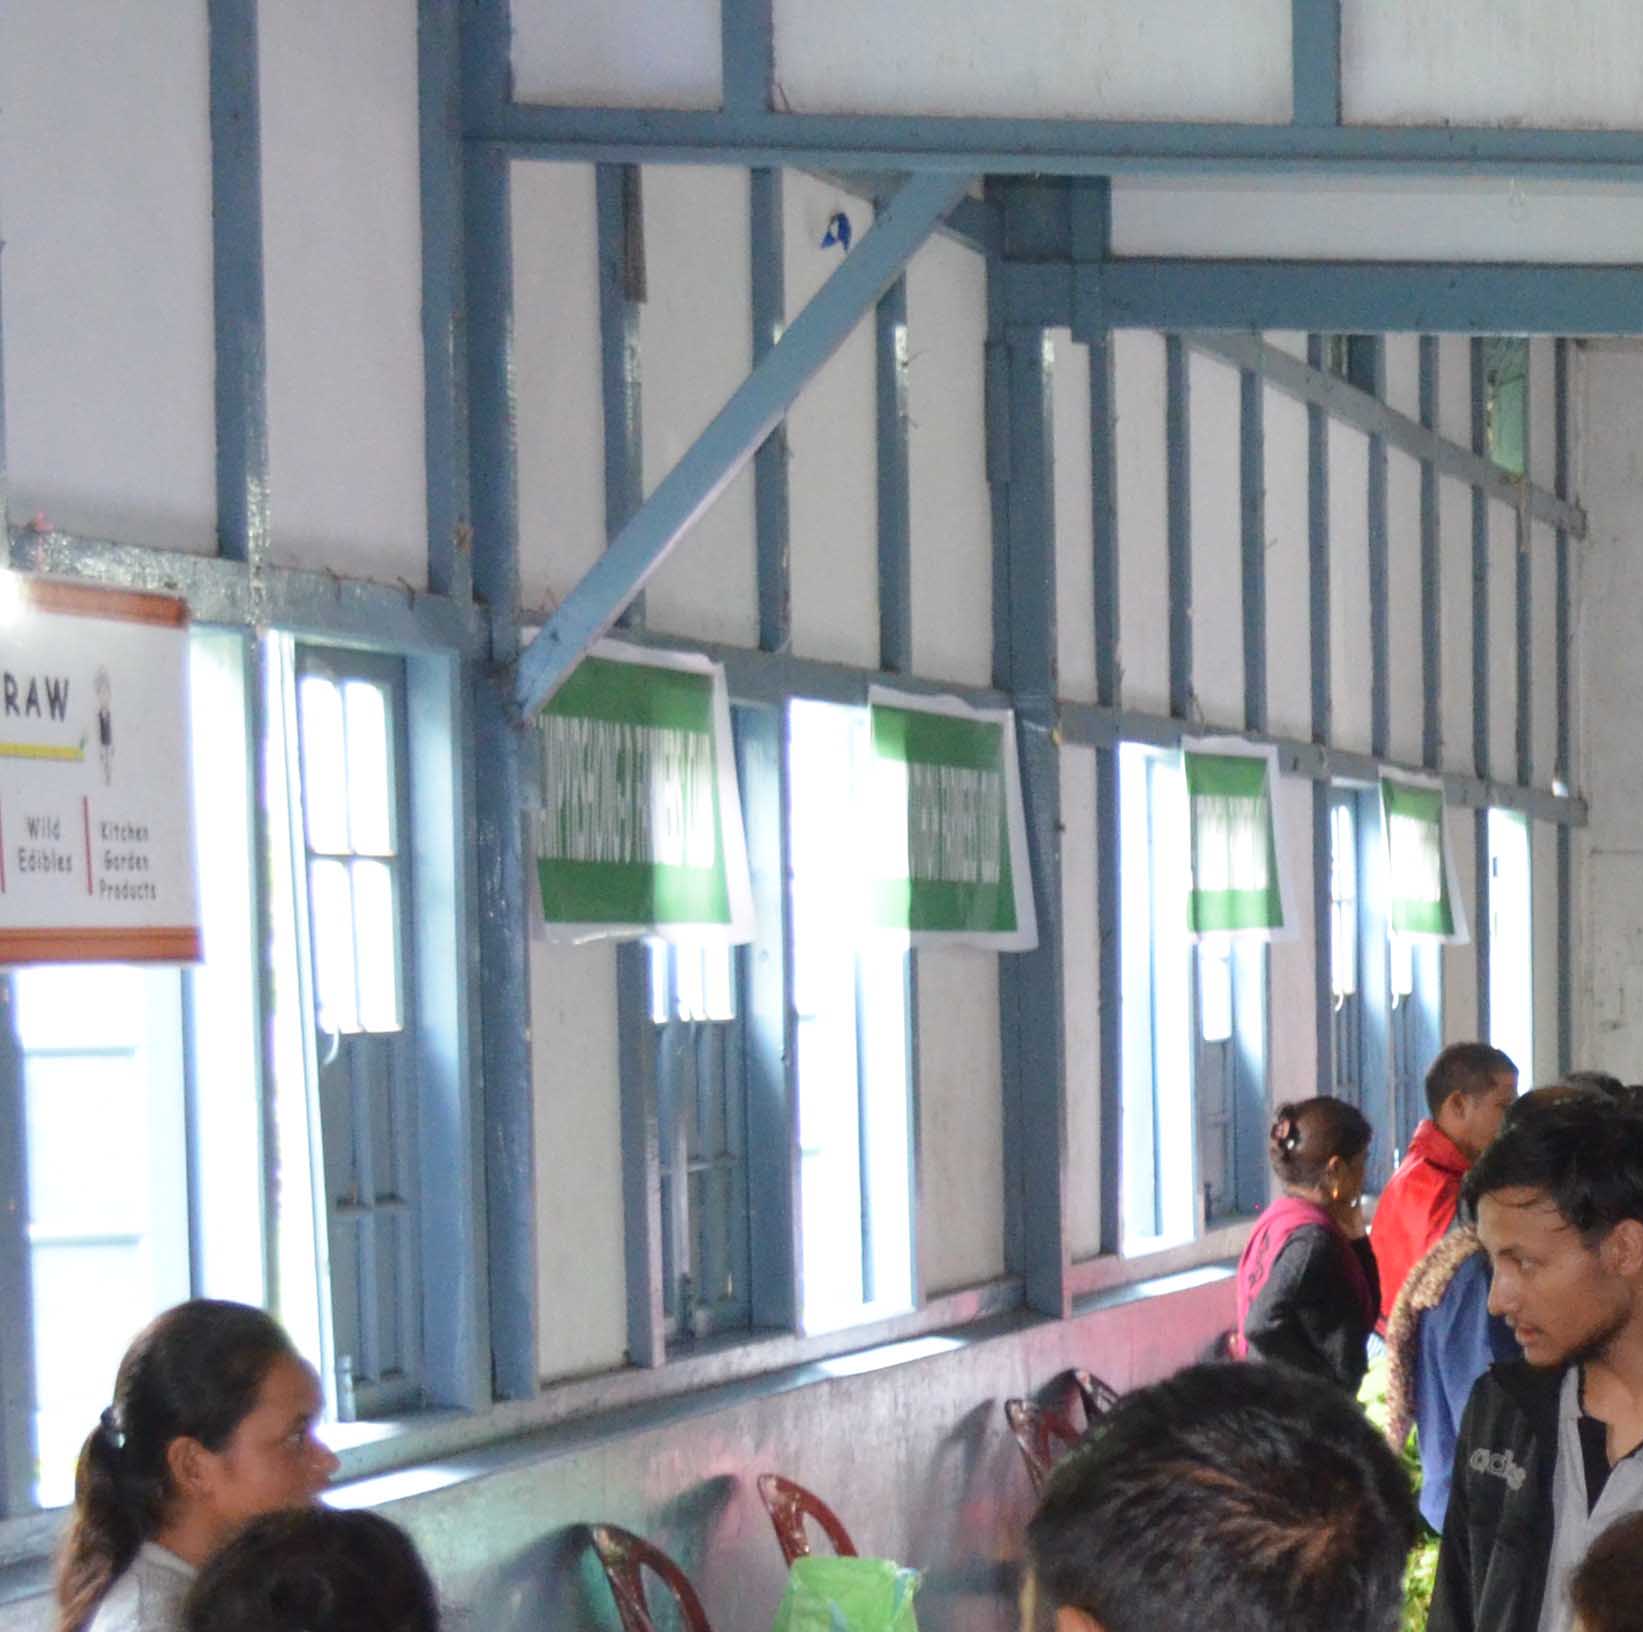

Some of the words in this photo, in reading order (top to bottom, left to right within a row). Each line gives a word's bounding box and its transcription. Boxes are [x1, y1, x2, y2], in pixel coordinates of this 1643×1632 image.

[4, 671, 70, 722] RAW
[27, 816, 61, 841] Wild
[100, 821, 150, 842] Kitchen
[18, 847, 73, 873] Edibles
[103, 850, 149, 872] Garden
[100, 878, 158, 900] Products
